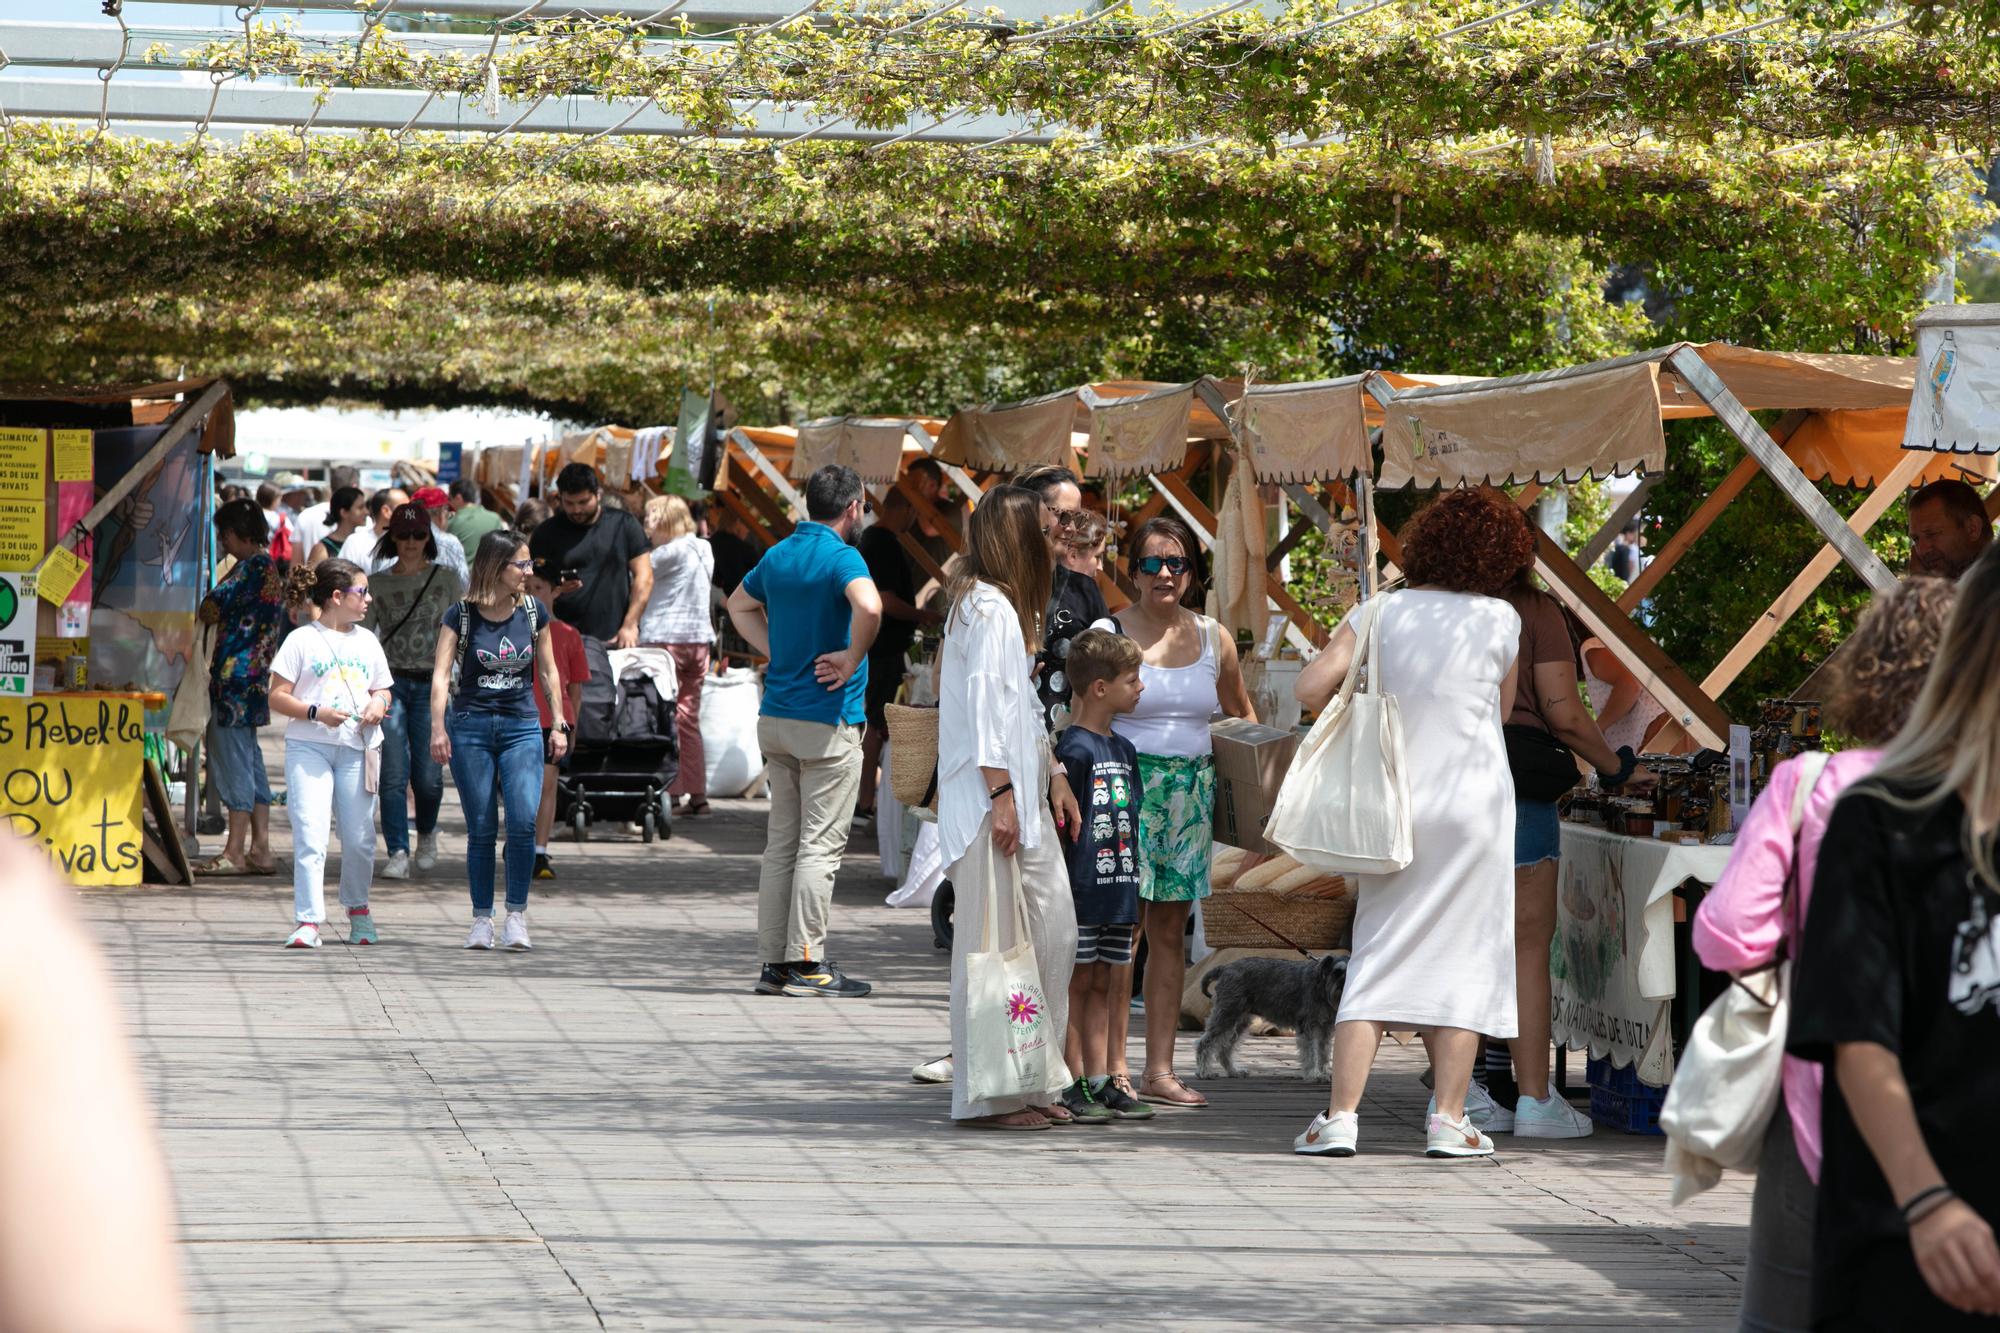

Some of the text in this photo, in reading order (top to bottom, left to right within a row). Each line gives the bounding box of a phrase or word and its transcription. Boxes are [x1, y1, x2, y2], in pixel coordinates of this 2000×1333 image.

[9, 471, 18, 479] DE
[20, 471, 39, 480] LUXE
[0, 504, 37, 514] LIMATICA
[8, 542, 16, 550] DE
[19, 542, 38, 551] LUJO
[0, 553, 31, 562] IVADOS
[477, 673, 527, 691] adida
[0, 798, 139, 873] Pivats
[1608, 1015, 1622, 1044] DE
